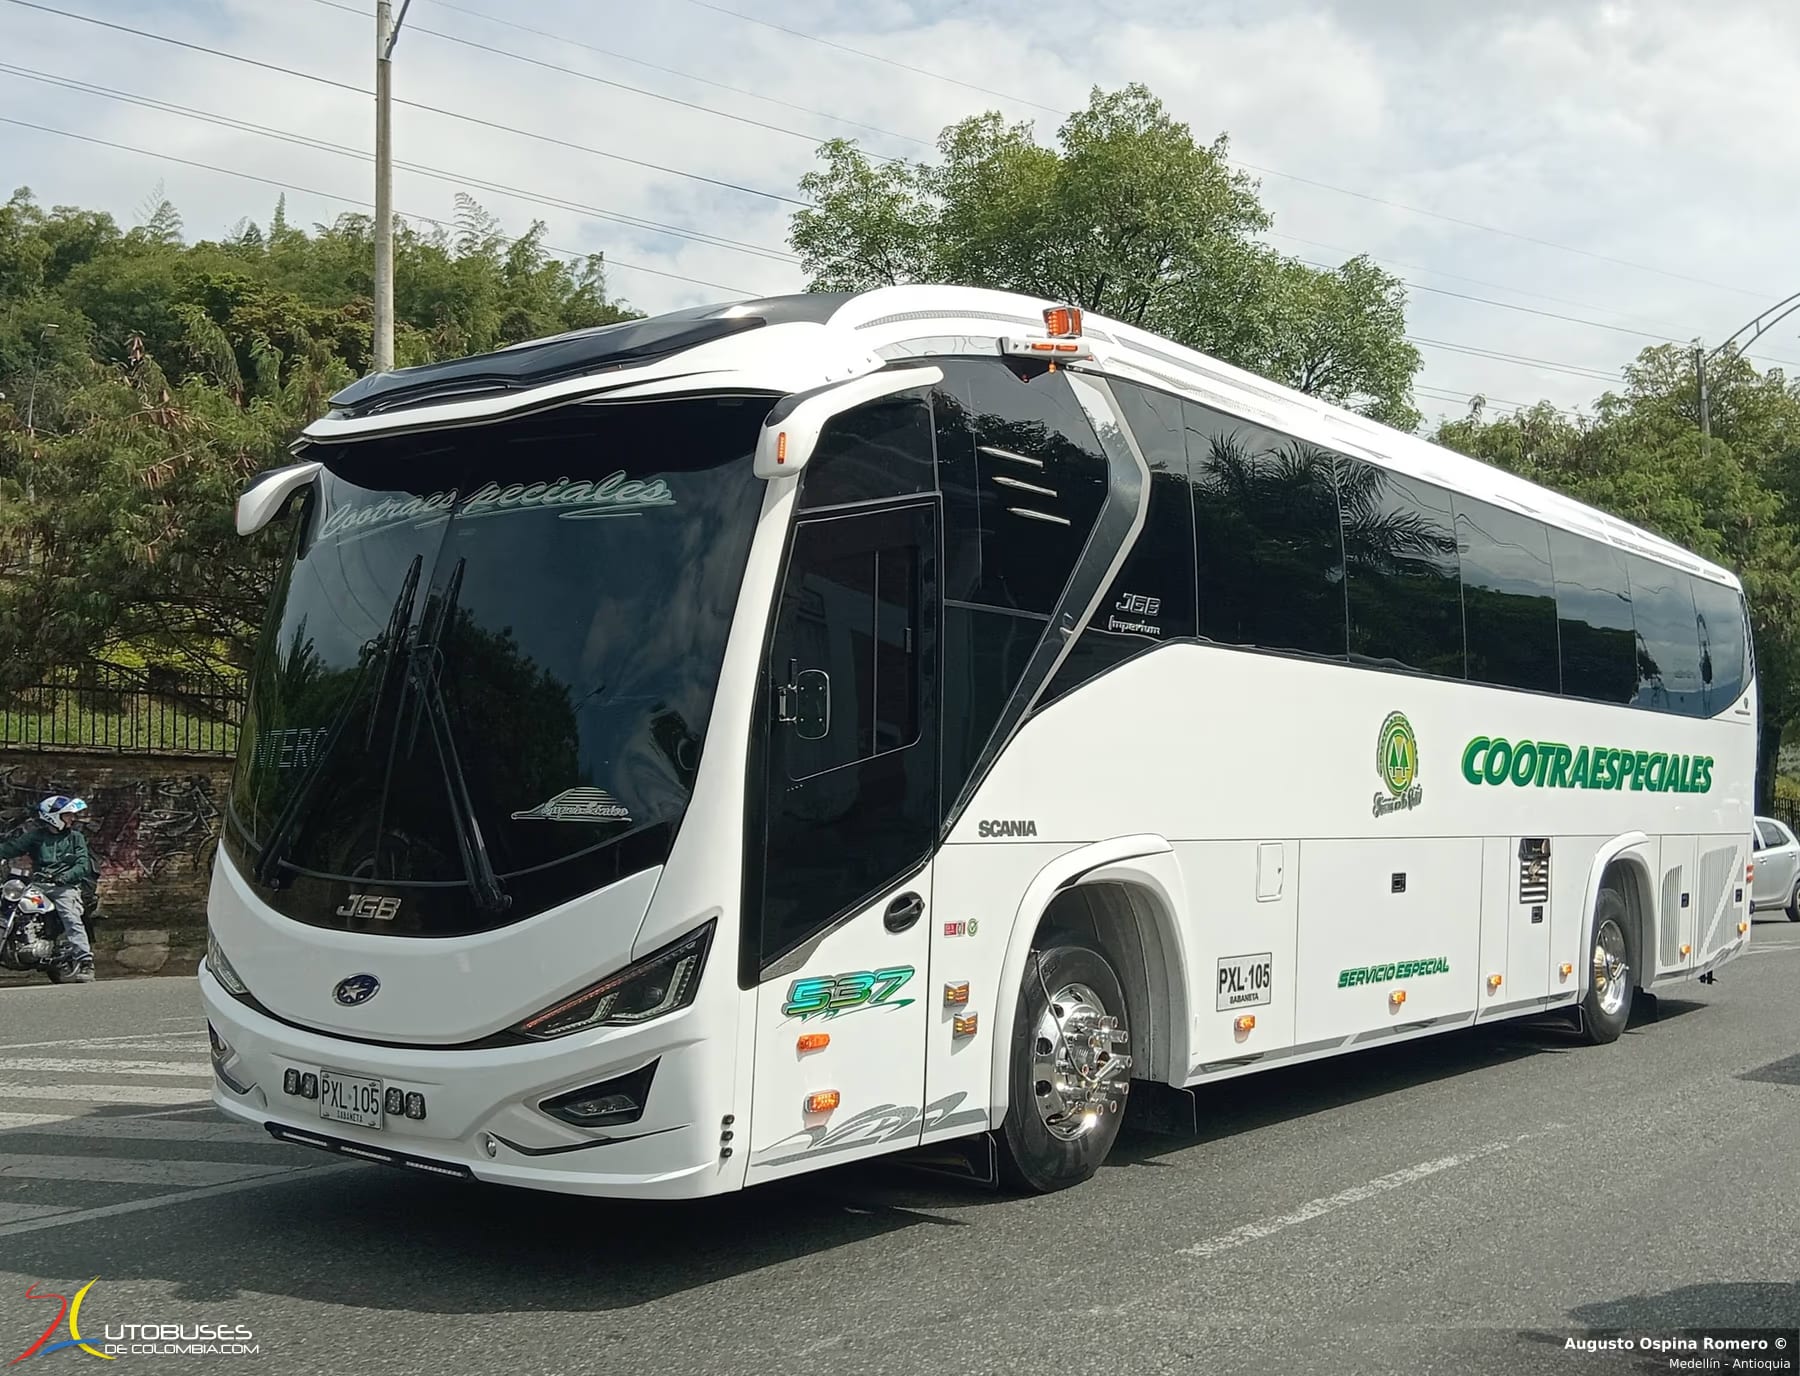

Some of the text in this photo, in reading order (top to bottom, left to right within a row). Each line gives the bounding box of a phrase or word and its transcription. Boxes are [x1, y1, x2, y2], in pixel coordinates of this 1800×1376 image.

[1115, 592, 1161, 616] JGB
[1108, 615, 1160, 636] Imperium
[1461, 736, 1714, 793] COOTRAESPECIALES
[978, 820, 1037, 837] SCANIA
[336, 894, 402, 920] JGB
[1337, 957, 1449, 988] SERVICIO ESPECIAL
[780, 964, 915, 1017] 537
